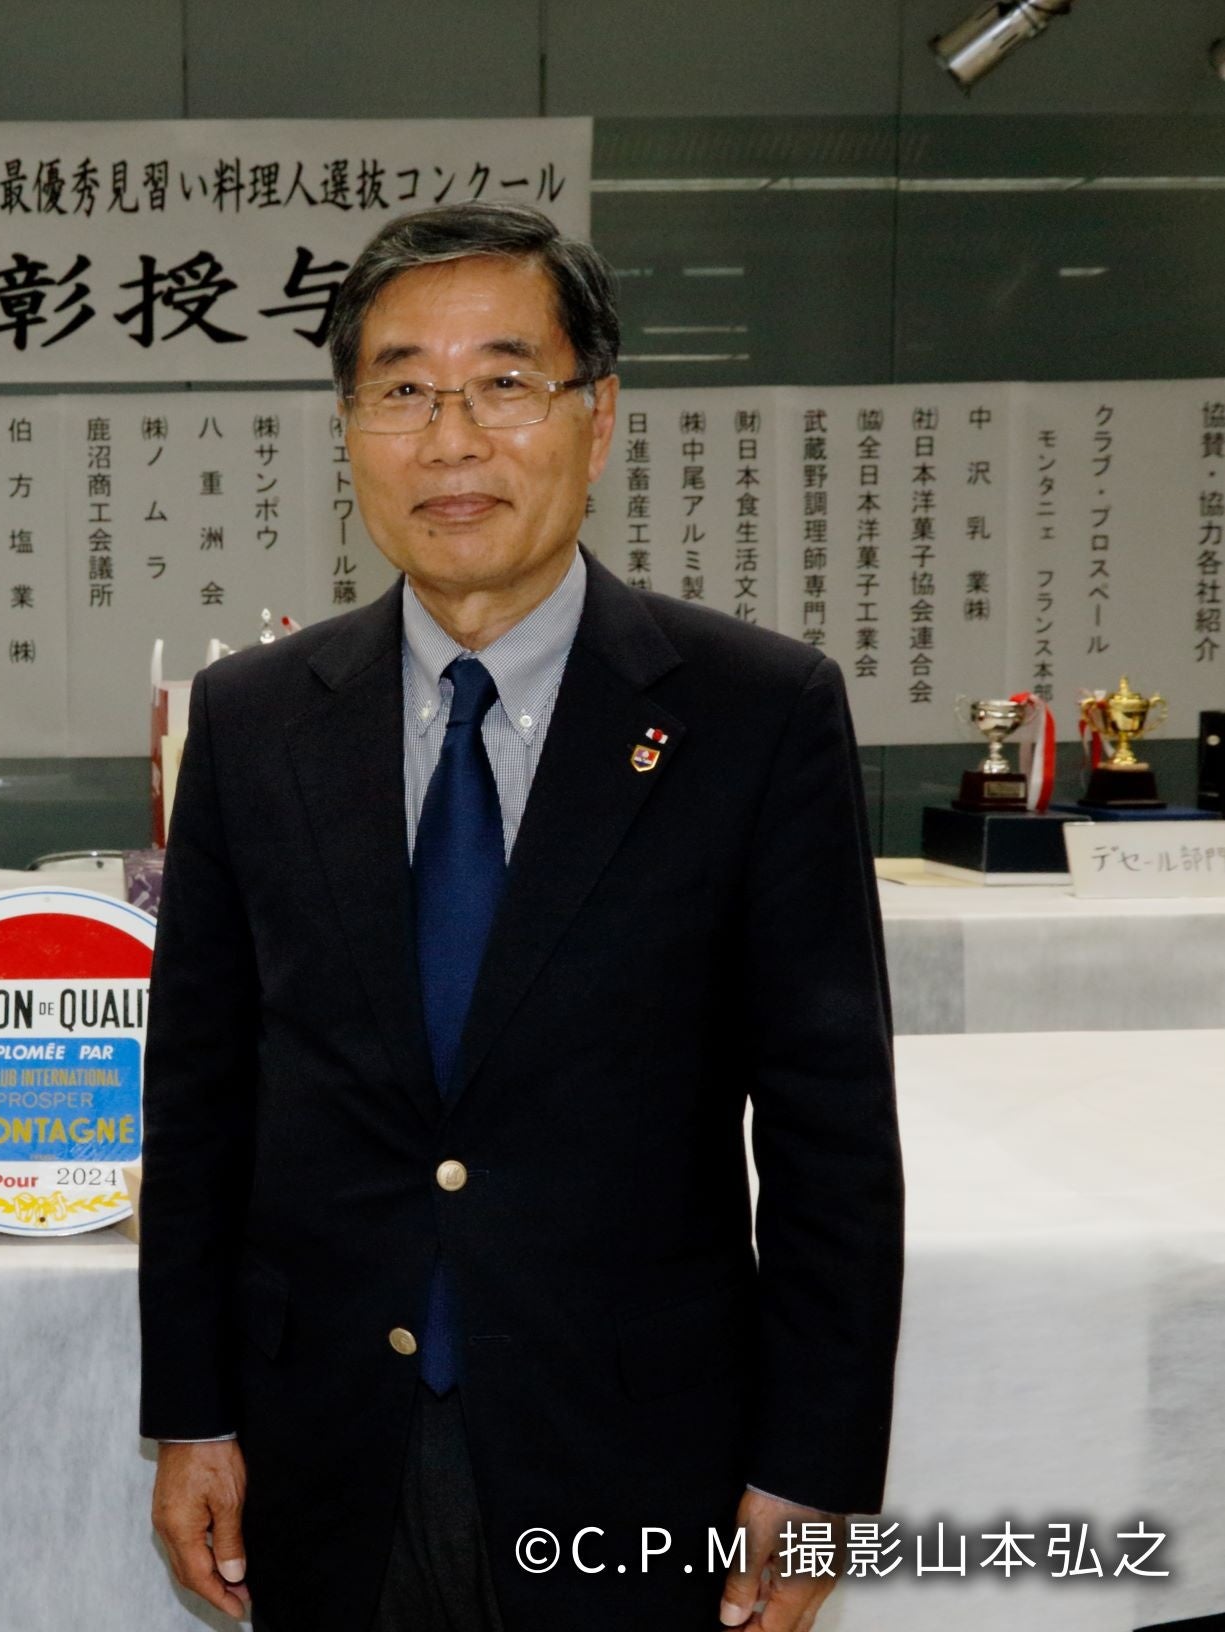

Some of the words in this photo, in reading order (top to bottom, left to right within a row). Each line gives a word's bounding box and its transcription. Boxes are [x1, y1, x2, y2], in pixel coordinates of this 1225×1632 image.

[87, 416, 114, 608] 鹿沼商工会議所
[198, 416, 225, 606] 八重洲会
[39, 1001, 55, 1016] DE
[59, 987, 151, 1032] QUALI
[79, 1045, 113, 1060] PAR
[21, 1068, 121, 1087] INTERNATIONAL
[56, 1167, 118, 1186] 2024
